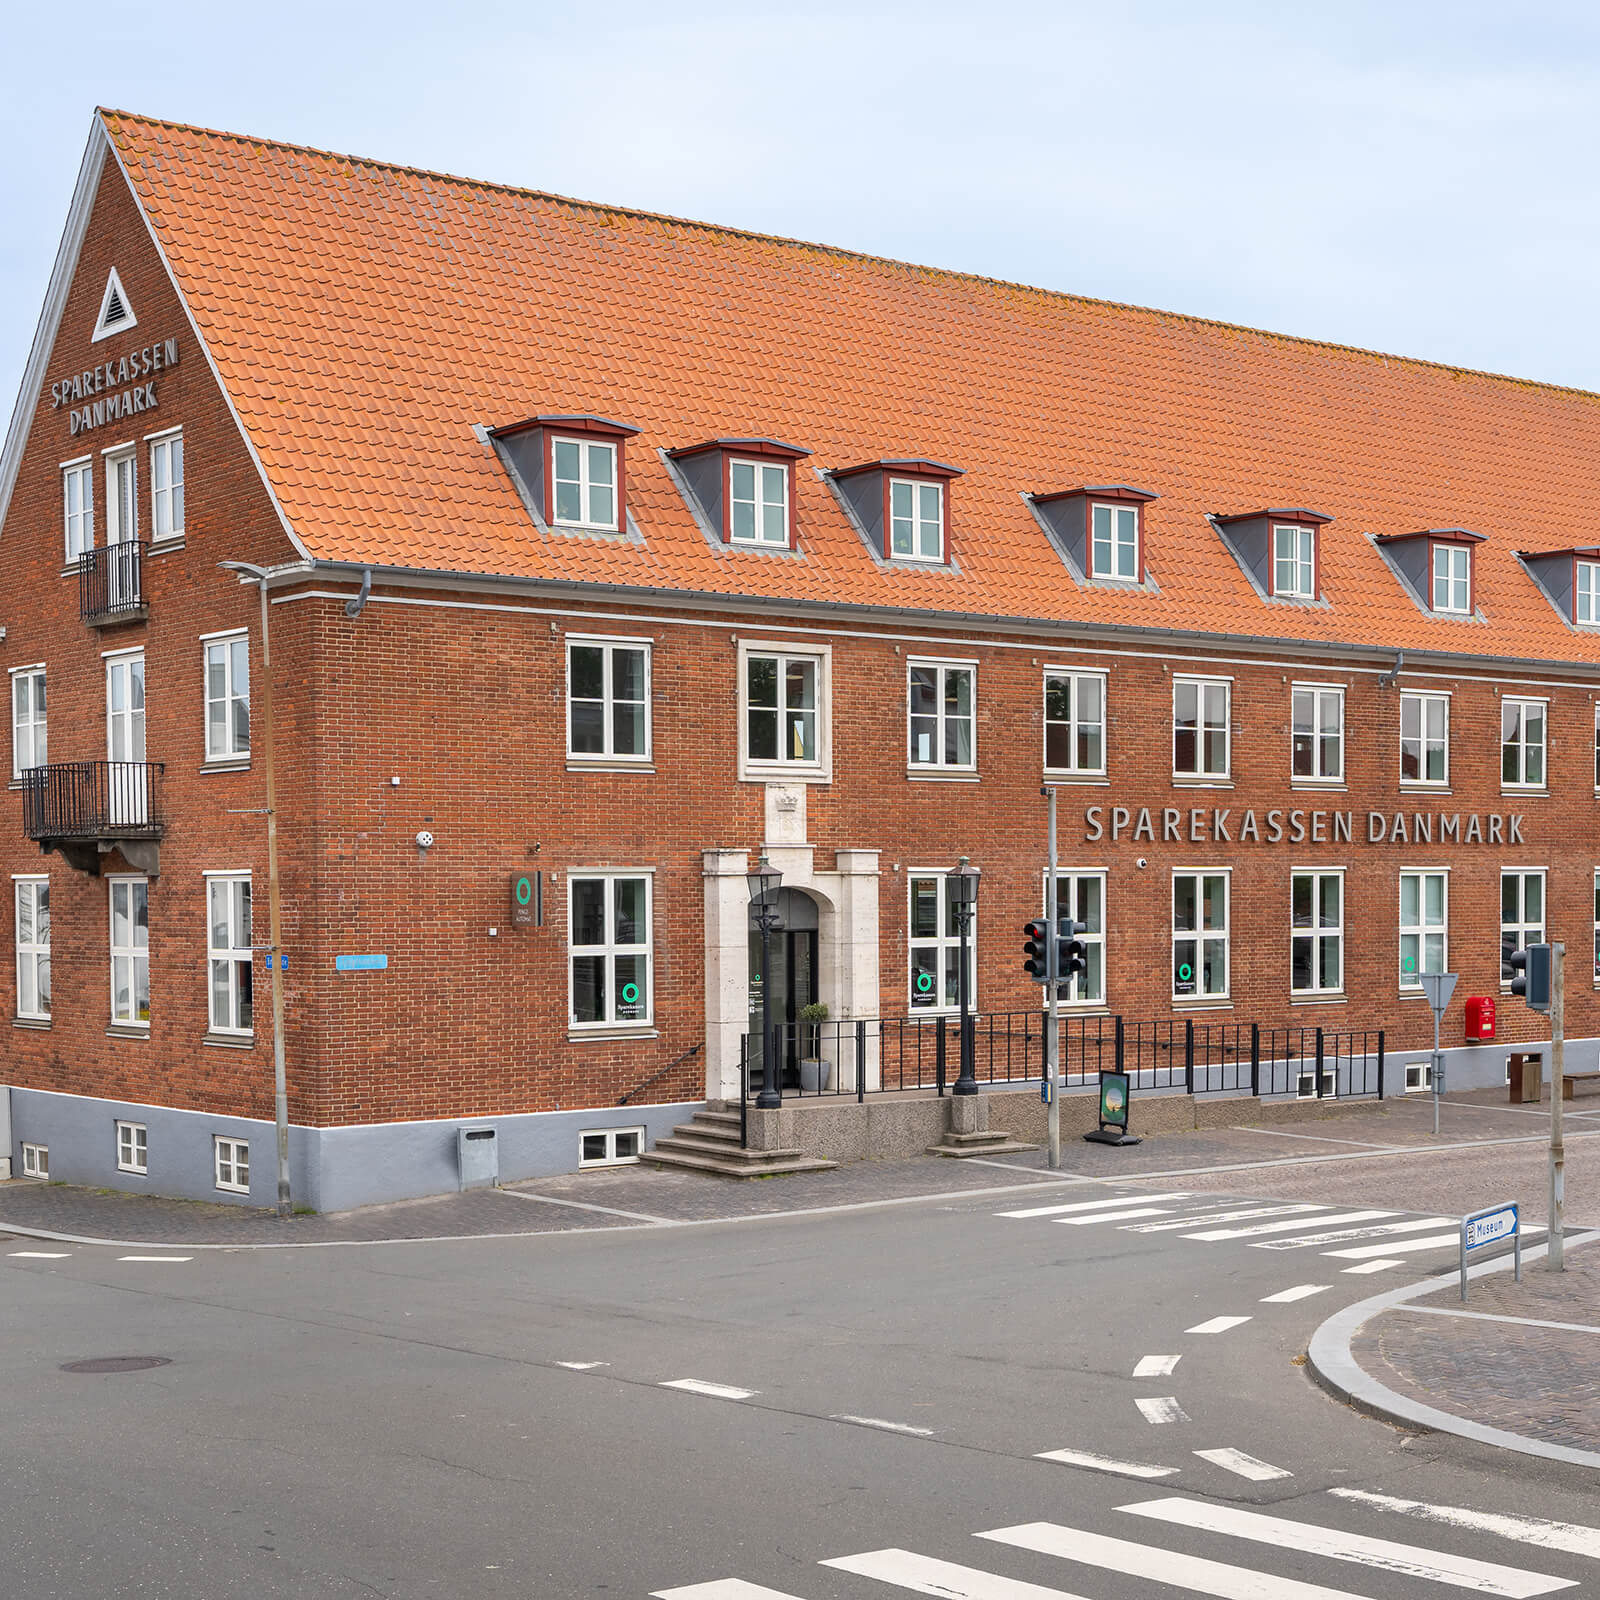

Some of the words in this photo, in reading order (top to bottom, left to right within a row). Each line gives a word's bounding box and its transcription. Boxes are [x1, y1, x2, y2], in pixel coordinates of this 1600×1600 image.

[51, 338, 179, 409] SPAREKASSEN
[69, 381, 160, 436] DANMARK
[1084, 806, 1353, 842] SPAREKASSEN
[1368, 811, 1526, 843] DANMARK
[1476, 1220, 1504, 1237] Museum
